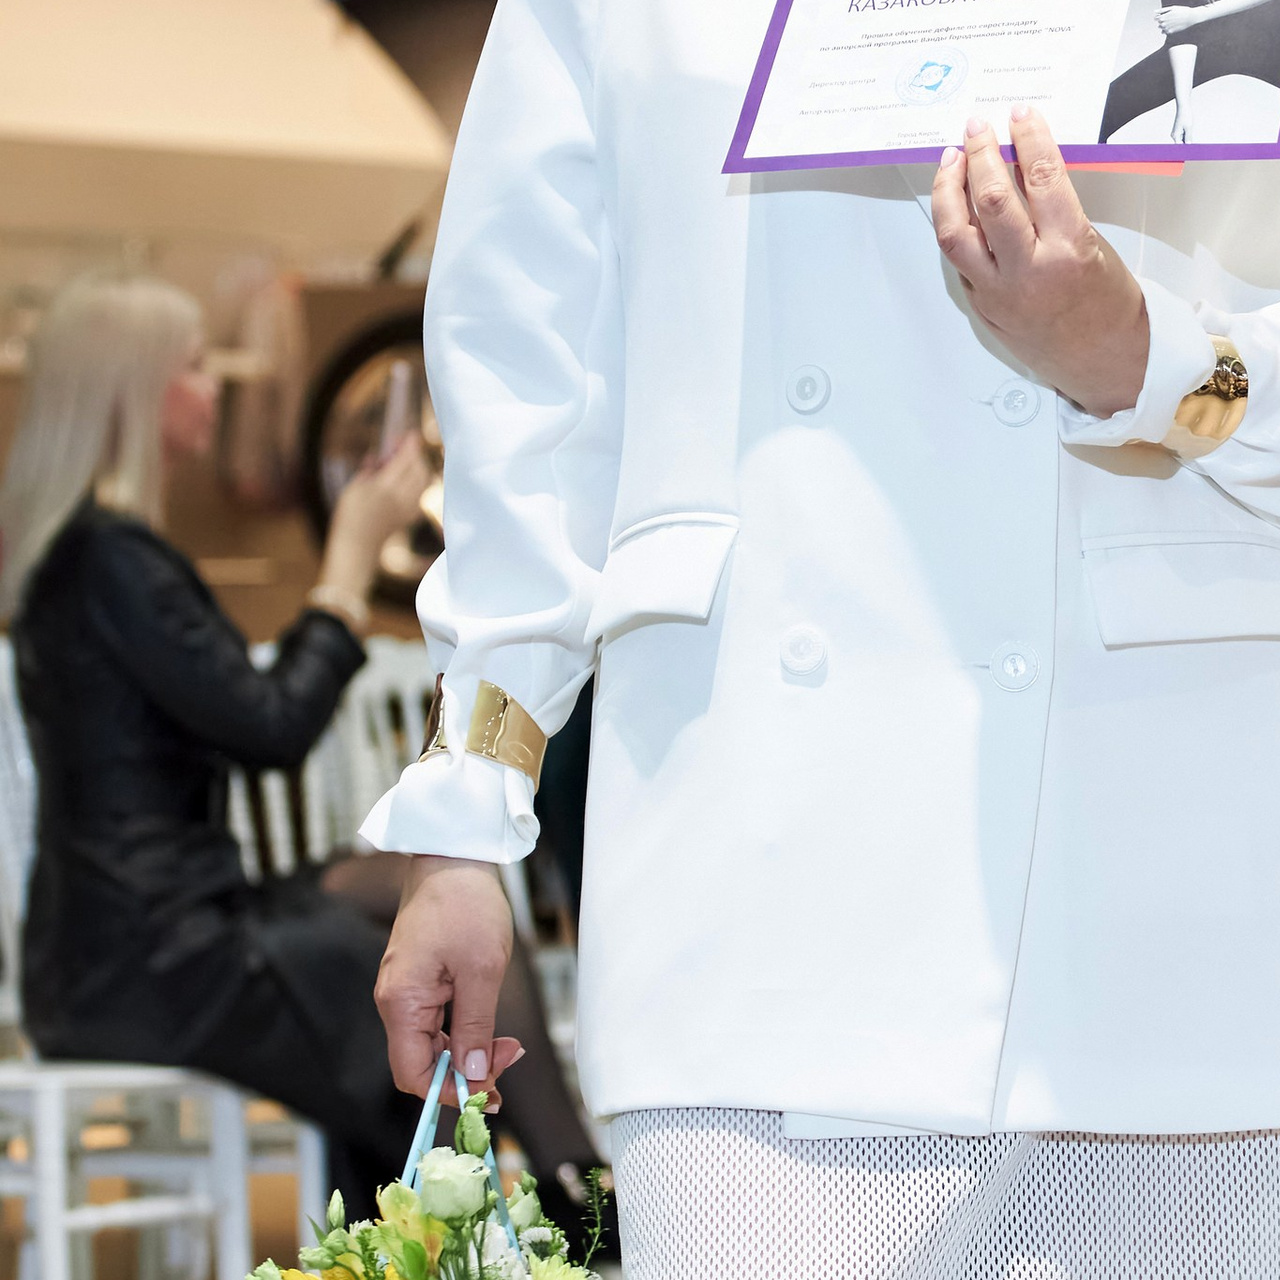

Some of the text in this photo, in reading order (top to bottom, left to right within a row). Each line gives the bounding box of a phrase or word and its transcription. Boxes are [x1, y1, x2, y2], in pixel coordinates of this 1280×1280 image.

[861, 32, 893, 40] Прошла
[894, 28, 932, 37] обучение
[933, 24, 966, 34] дефиле
[978, 19, 1039, 30] евростандарту
[831, 42, 873, 51] авторской
[873, 38, 919, 48] программе
[920, 36, 948, 44] Ванды
[948, 30, 1006, 40] Городчиковой
[1013, 28, 1043, 36] центре
[1017, 65, 1051, 73] Бушуева
[808, 80, 847, 89] Директор
[1001, 94, 1052, 102] Городчикова
[799, 108, 823, 116] Автор
[849, 103, 908, 113] преподаватель
